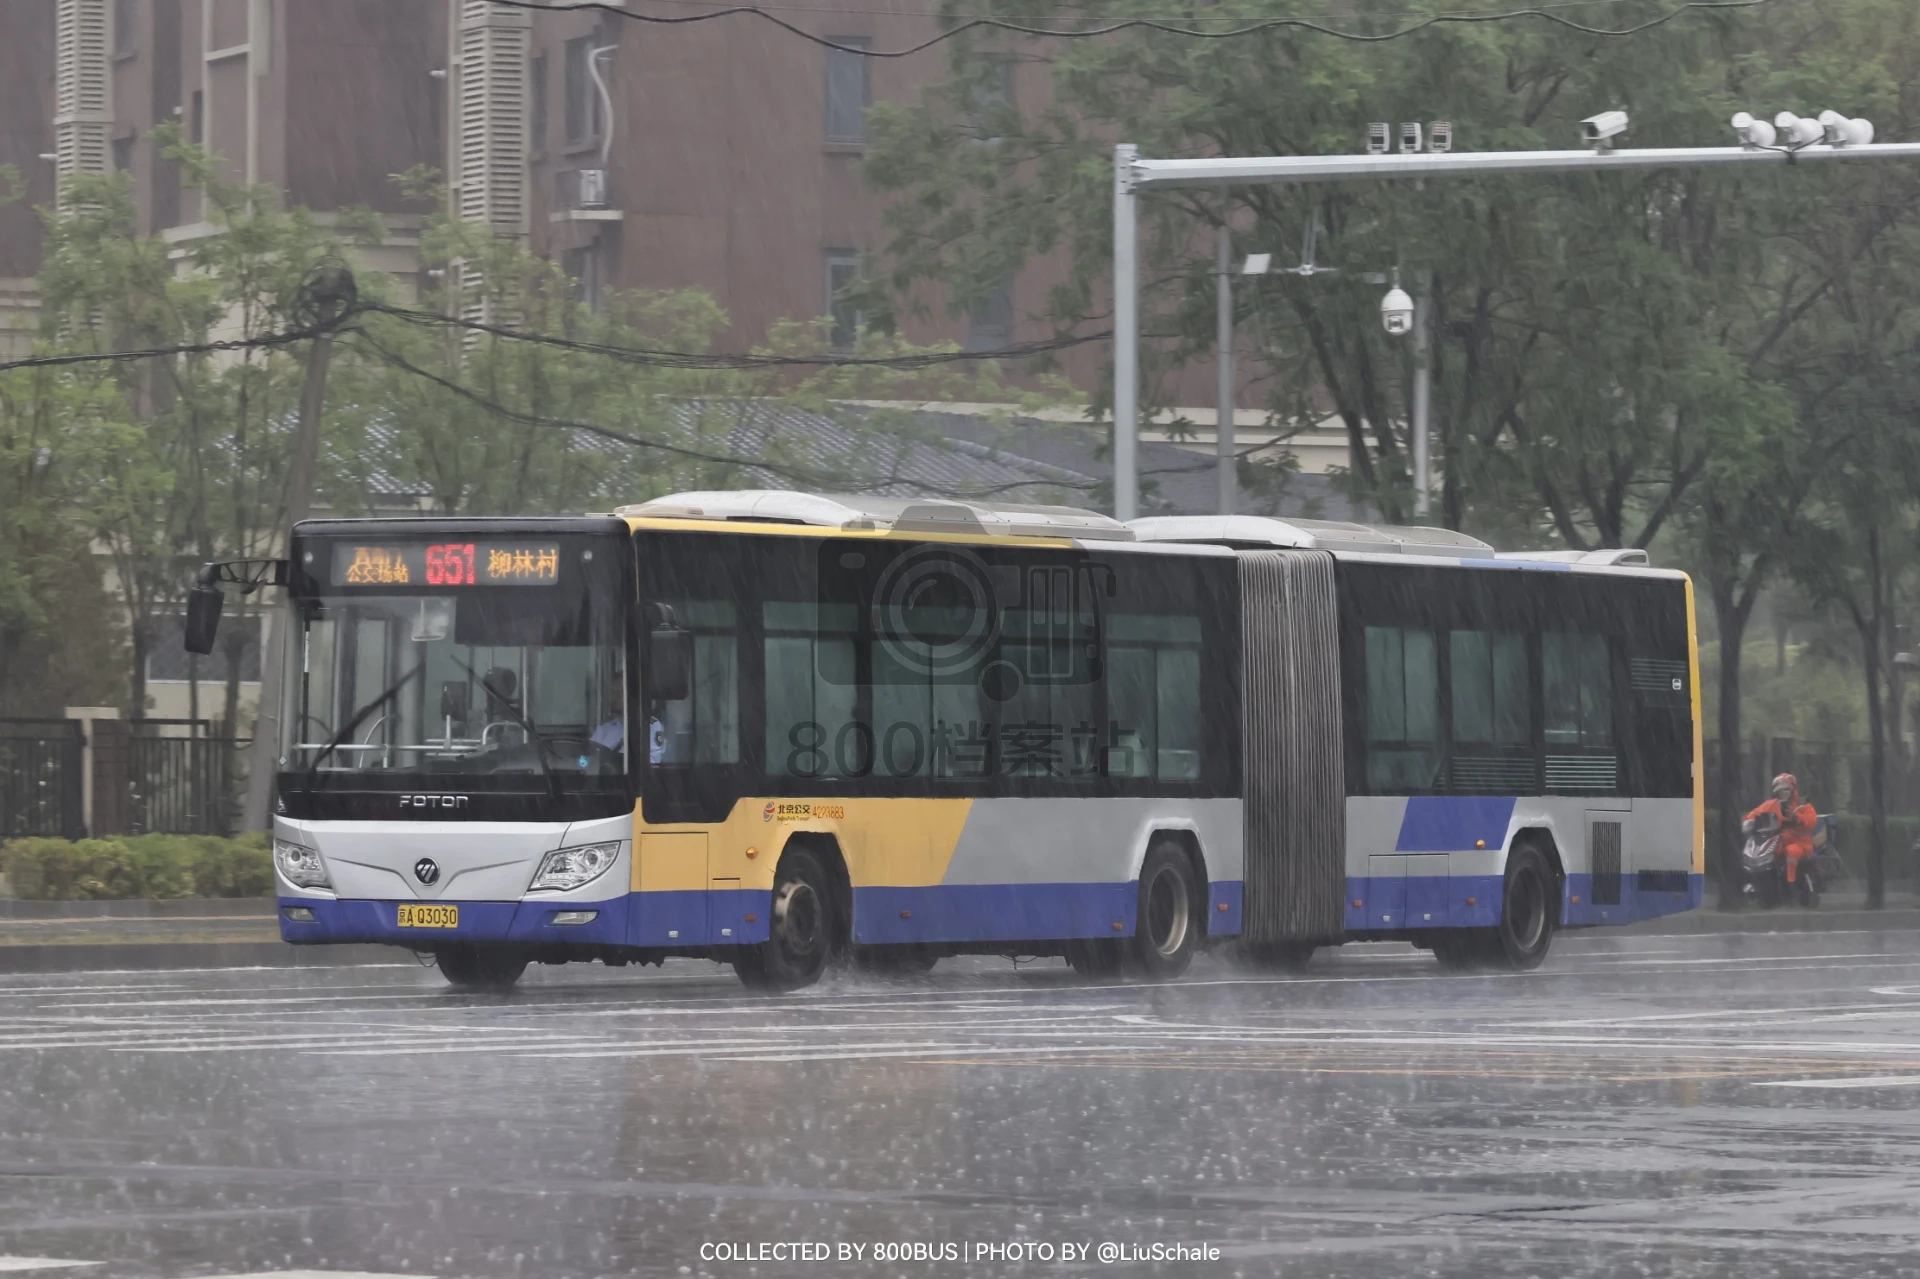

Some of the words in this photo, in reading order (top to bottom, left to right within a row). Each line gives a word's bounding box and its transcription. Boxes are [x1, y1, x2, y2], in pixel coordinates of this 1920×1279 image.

[425, 543, 477, 585] 651
[487, 548, 558, 579] 柳林村
[400, 795, 469, 808] FOTON
[777, 804, 811, 815] 北京公交
